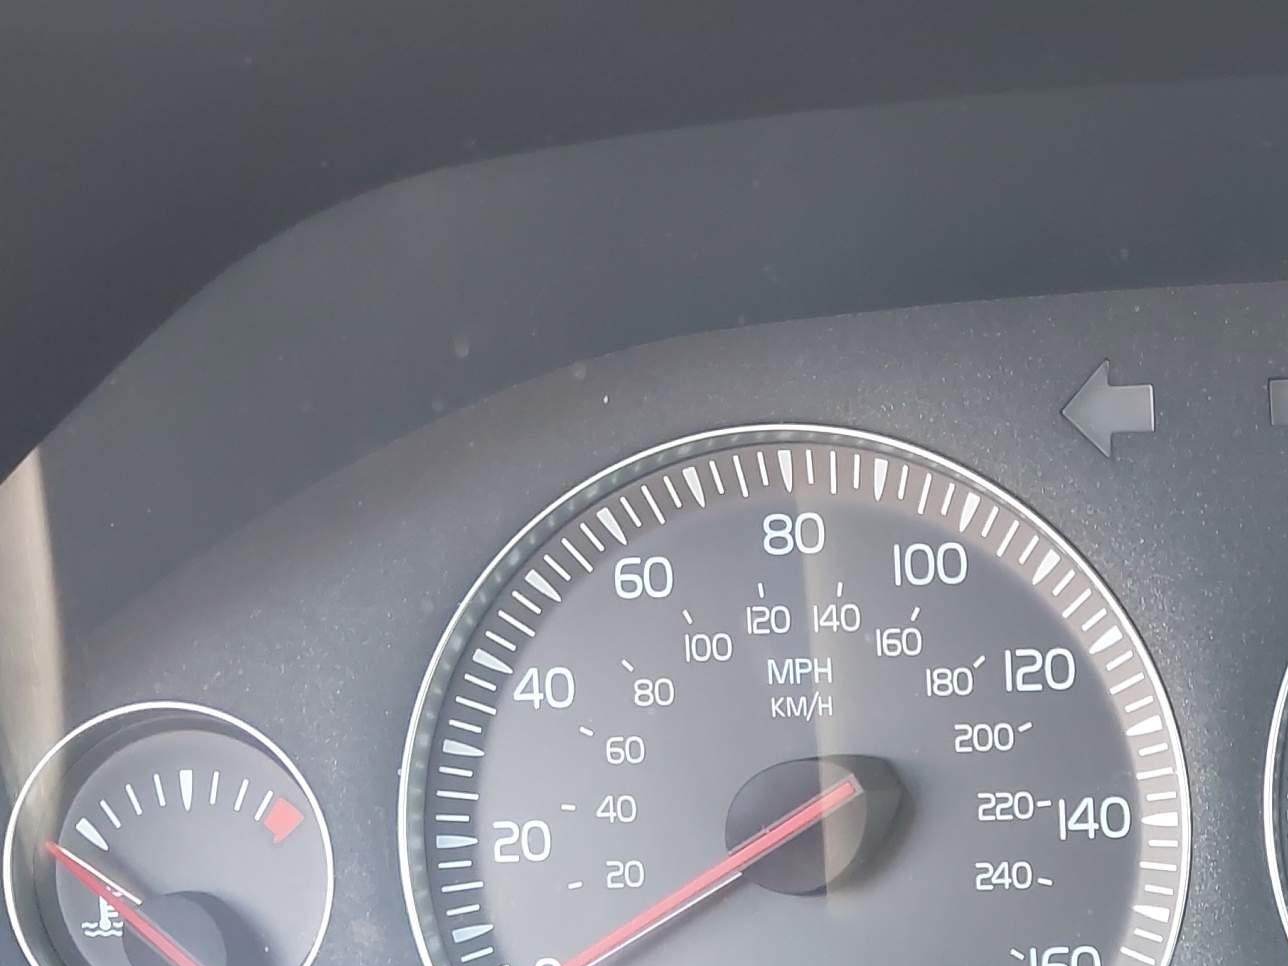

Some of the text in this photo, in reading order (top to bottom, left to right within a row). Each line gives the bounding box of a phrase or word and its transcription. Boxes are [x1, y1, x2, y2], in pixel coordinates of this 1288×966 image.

[764, 513, 824, 554] 80
[615, 557, 672, 598] 60
[894, 543, 967, 585] 100
[747, 606, 790, 634] 120
[814, 604, 860, 632] 140
[685, 633, 732, 662] 100
[876, 628, 921, 656] 160
[768, 658, 832, 684] MPH
[926, 668, 972, 696] 180
[1005, 648, 1075, 691] 120
[514, 666, 574, 709] 40
[635, 679, 674, 706] 80
[772, 691, 832, 720] KM/H
[607, 737, 644, 764] 60
[955, 723, 1013, 752] 200
[597, 796, 636, 822] 40
[978, 794, 1033, 820] 220
[1059, 797, 1130, 840] 140
[493, 821, 550, 862] 20
[607, 861, 644, 888] 20
[976, 862, 1031, 889] 240
